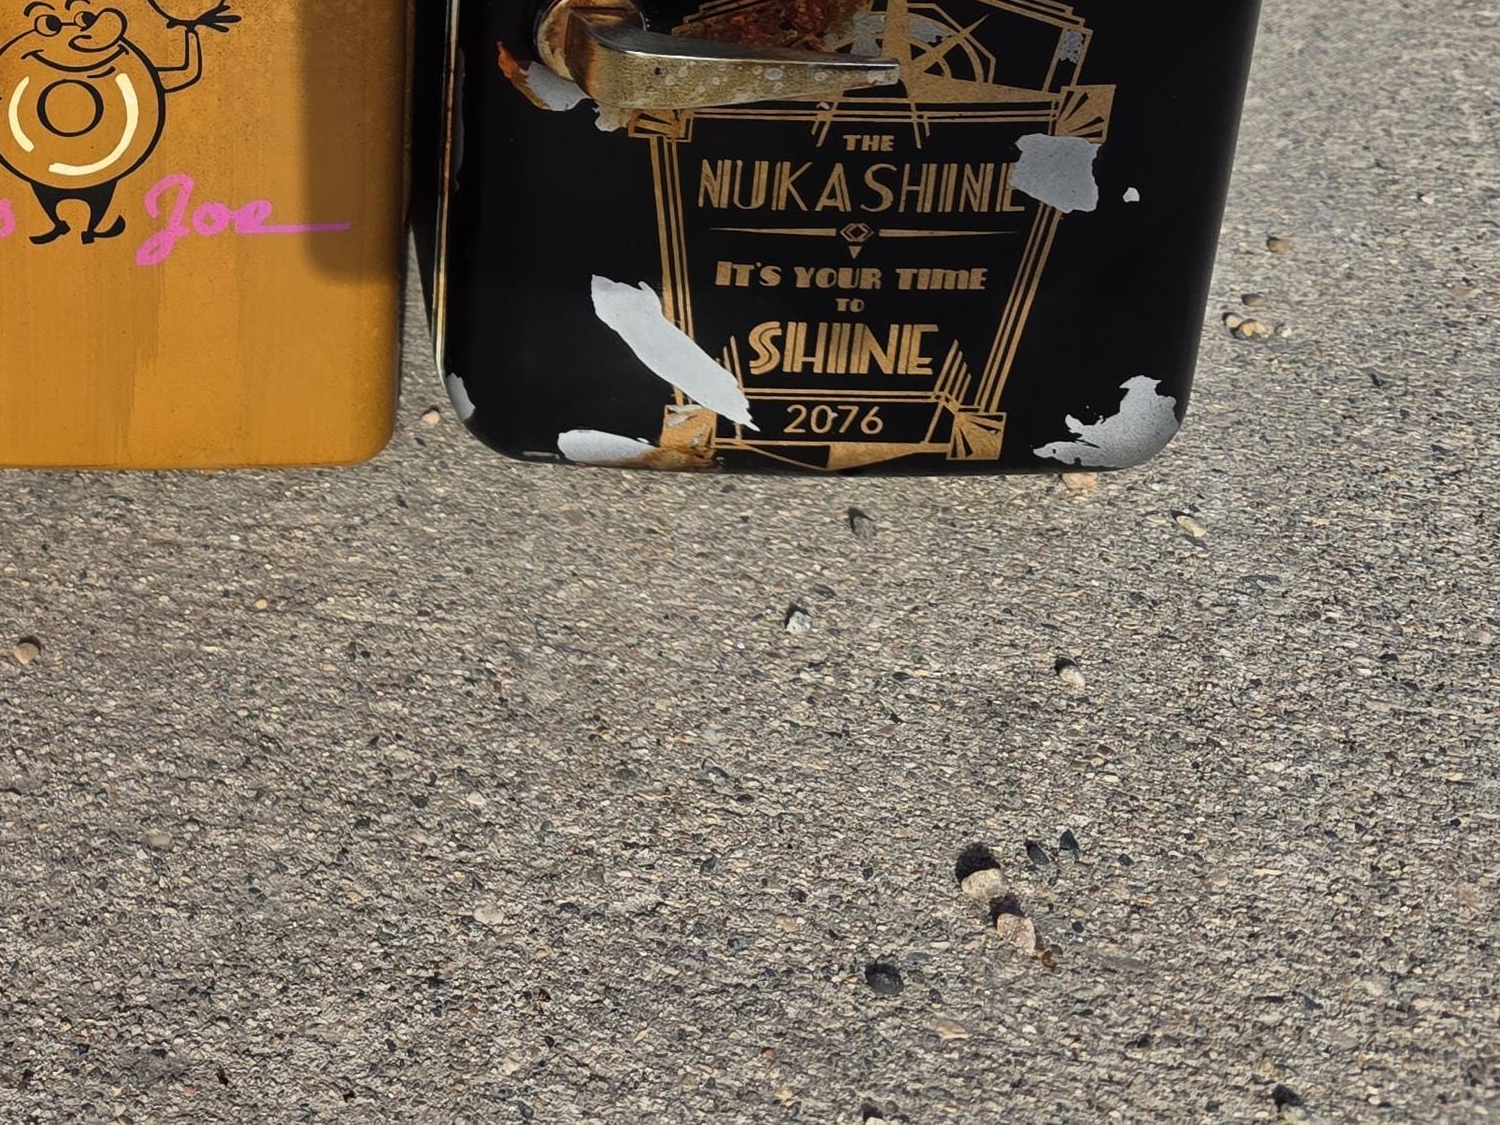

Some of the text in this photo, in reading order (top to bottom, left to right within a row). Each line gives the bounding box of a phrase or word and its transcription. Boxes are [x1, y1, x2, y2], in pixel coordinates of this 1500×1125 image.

[842, 134, 895, 152] THE
[135, 174, 349, 266] Joe
[715, 260, 988, 291] IT'S YOUR TIME
[835, 298, 865, 313] TO
[748, 320, 939, 375] SHINE
[783, 404, 884, 435] 2076
